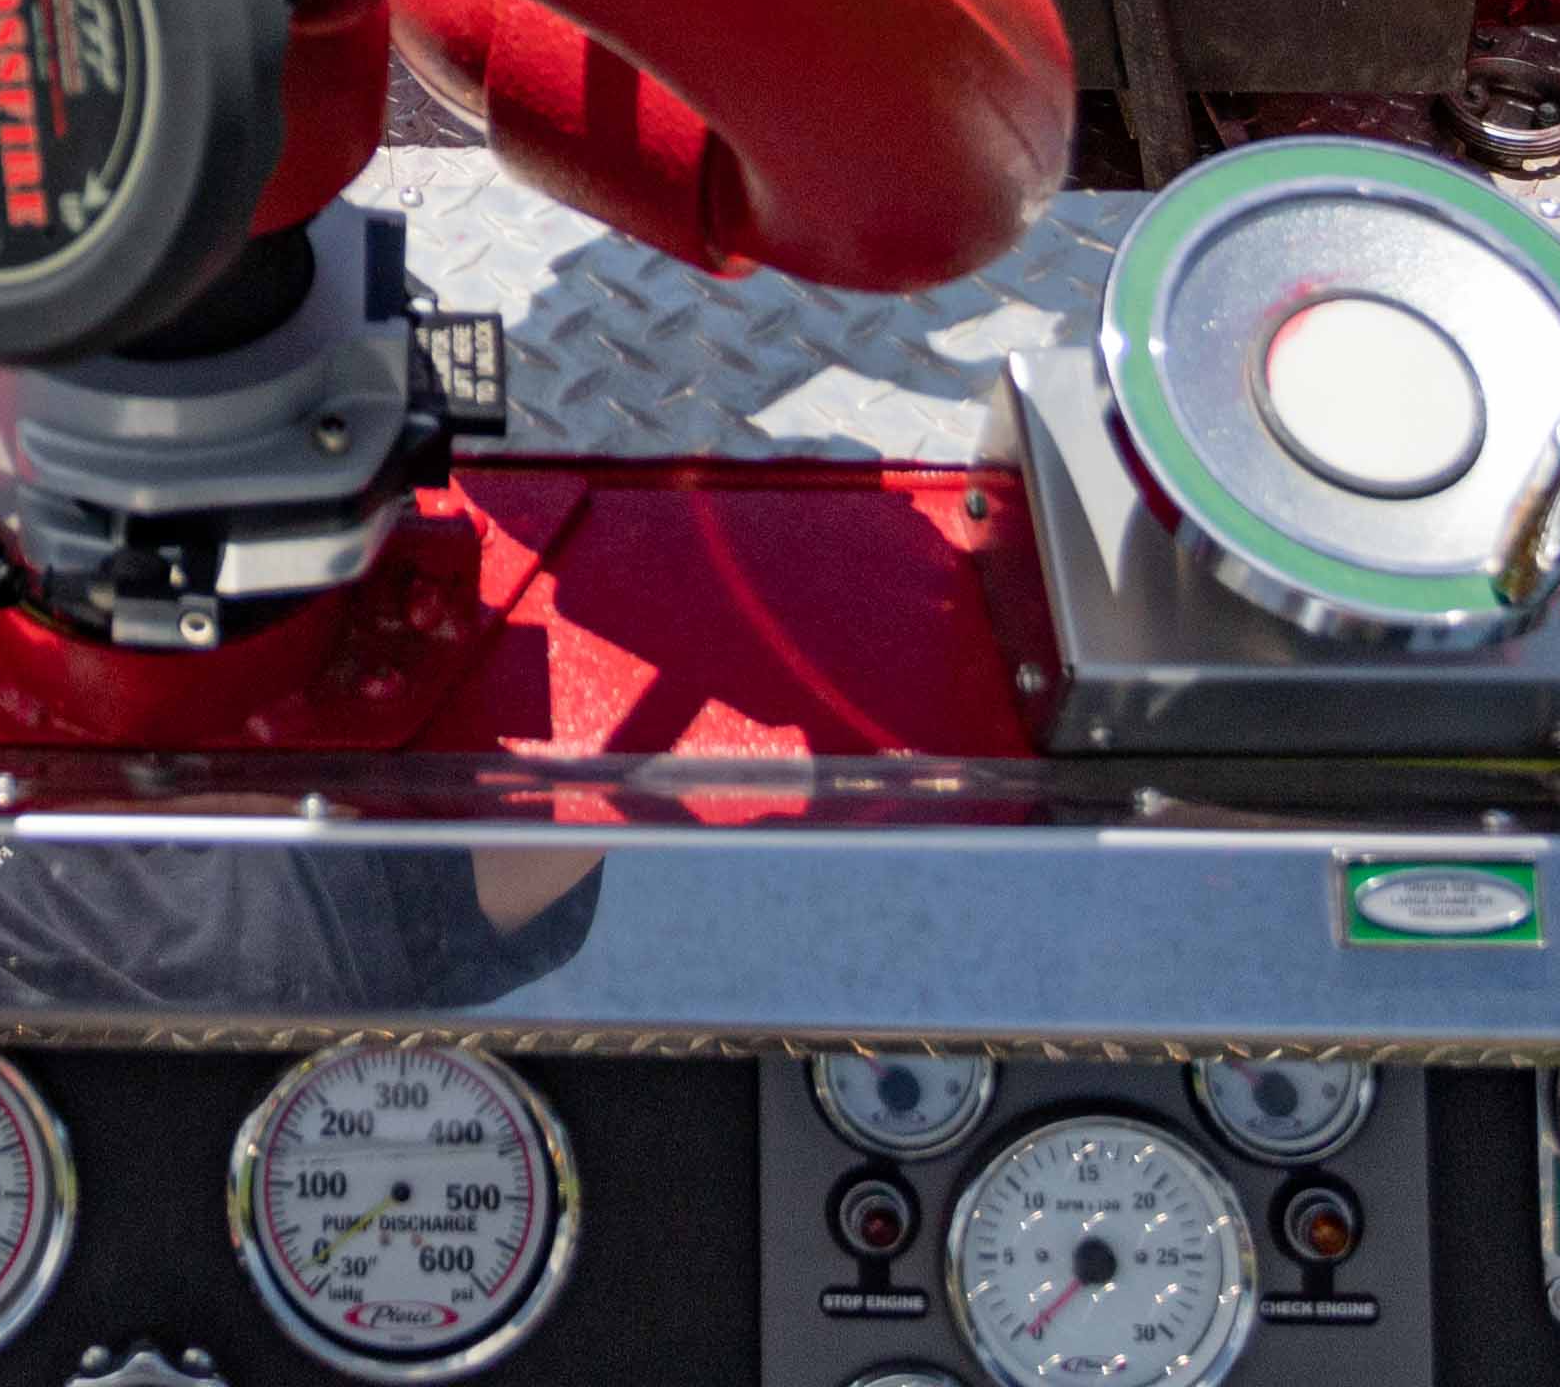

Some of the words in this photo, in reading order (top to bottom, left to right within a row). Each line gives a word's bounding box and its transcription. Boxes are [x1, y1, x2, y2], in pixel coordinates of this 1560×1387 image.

[58, 191, 85, 232] UP
[473, 318, 496, 376] UNLOCK
[1390, 895, 1429, 906] LARGE
[1431, 895, 1494, 906] DIAMETER
[375, 1082, 429, 1109] 300
[320, 1109, 375, 1138] 200
[428, 1119, 484, 1146] 400
[1076, 1163, 1100, 1183] 15
[295, 1171, 348, 1199] 100
[444, 1183, 502, 1212] 500
[1022, 1192, 1045, 1210] 10
[1095, 1199, 1121, 1212] 100
[1133, 1192, 1156, 1210] 20
[322, 1214, 374, 1232] PUMP
[379, 1215, 479, 1233] DISCHARGE
[312, 1237, 329, 1265] 0
[418, 1245, 474, 1273] 600
[1002, 1248, 1015, 1266] 5
[1155, 1248, 1180, 1266] 25
[328, 1286, 364, 1304] inHg
[450, 1285, 475, 1304] psi
[823, 1294, 864, 1309] STOP
[866, 1294, 926, 1310] ENGINE
[369, 1305, 433, 1328] Pierce
[1260, 1301, 1313, 1316] CHECK
[1316, 1301, 1377, 1317] ENGINE
[1031, 1323, 1044, 1341] 0
[1133, 1323, 1156, 1342] 30
